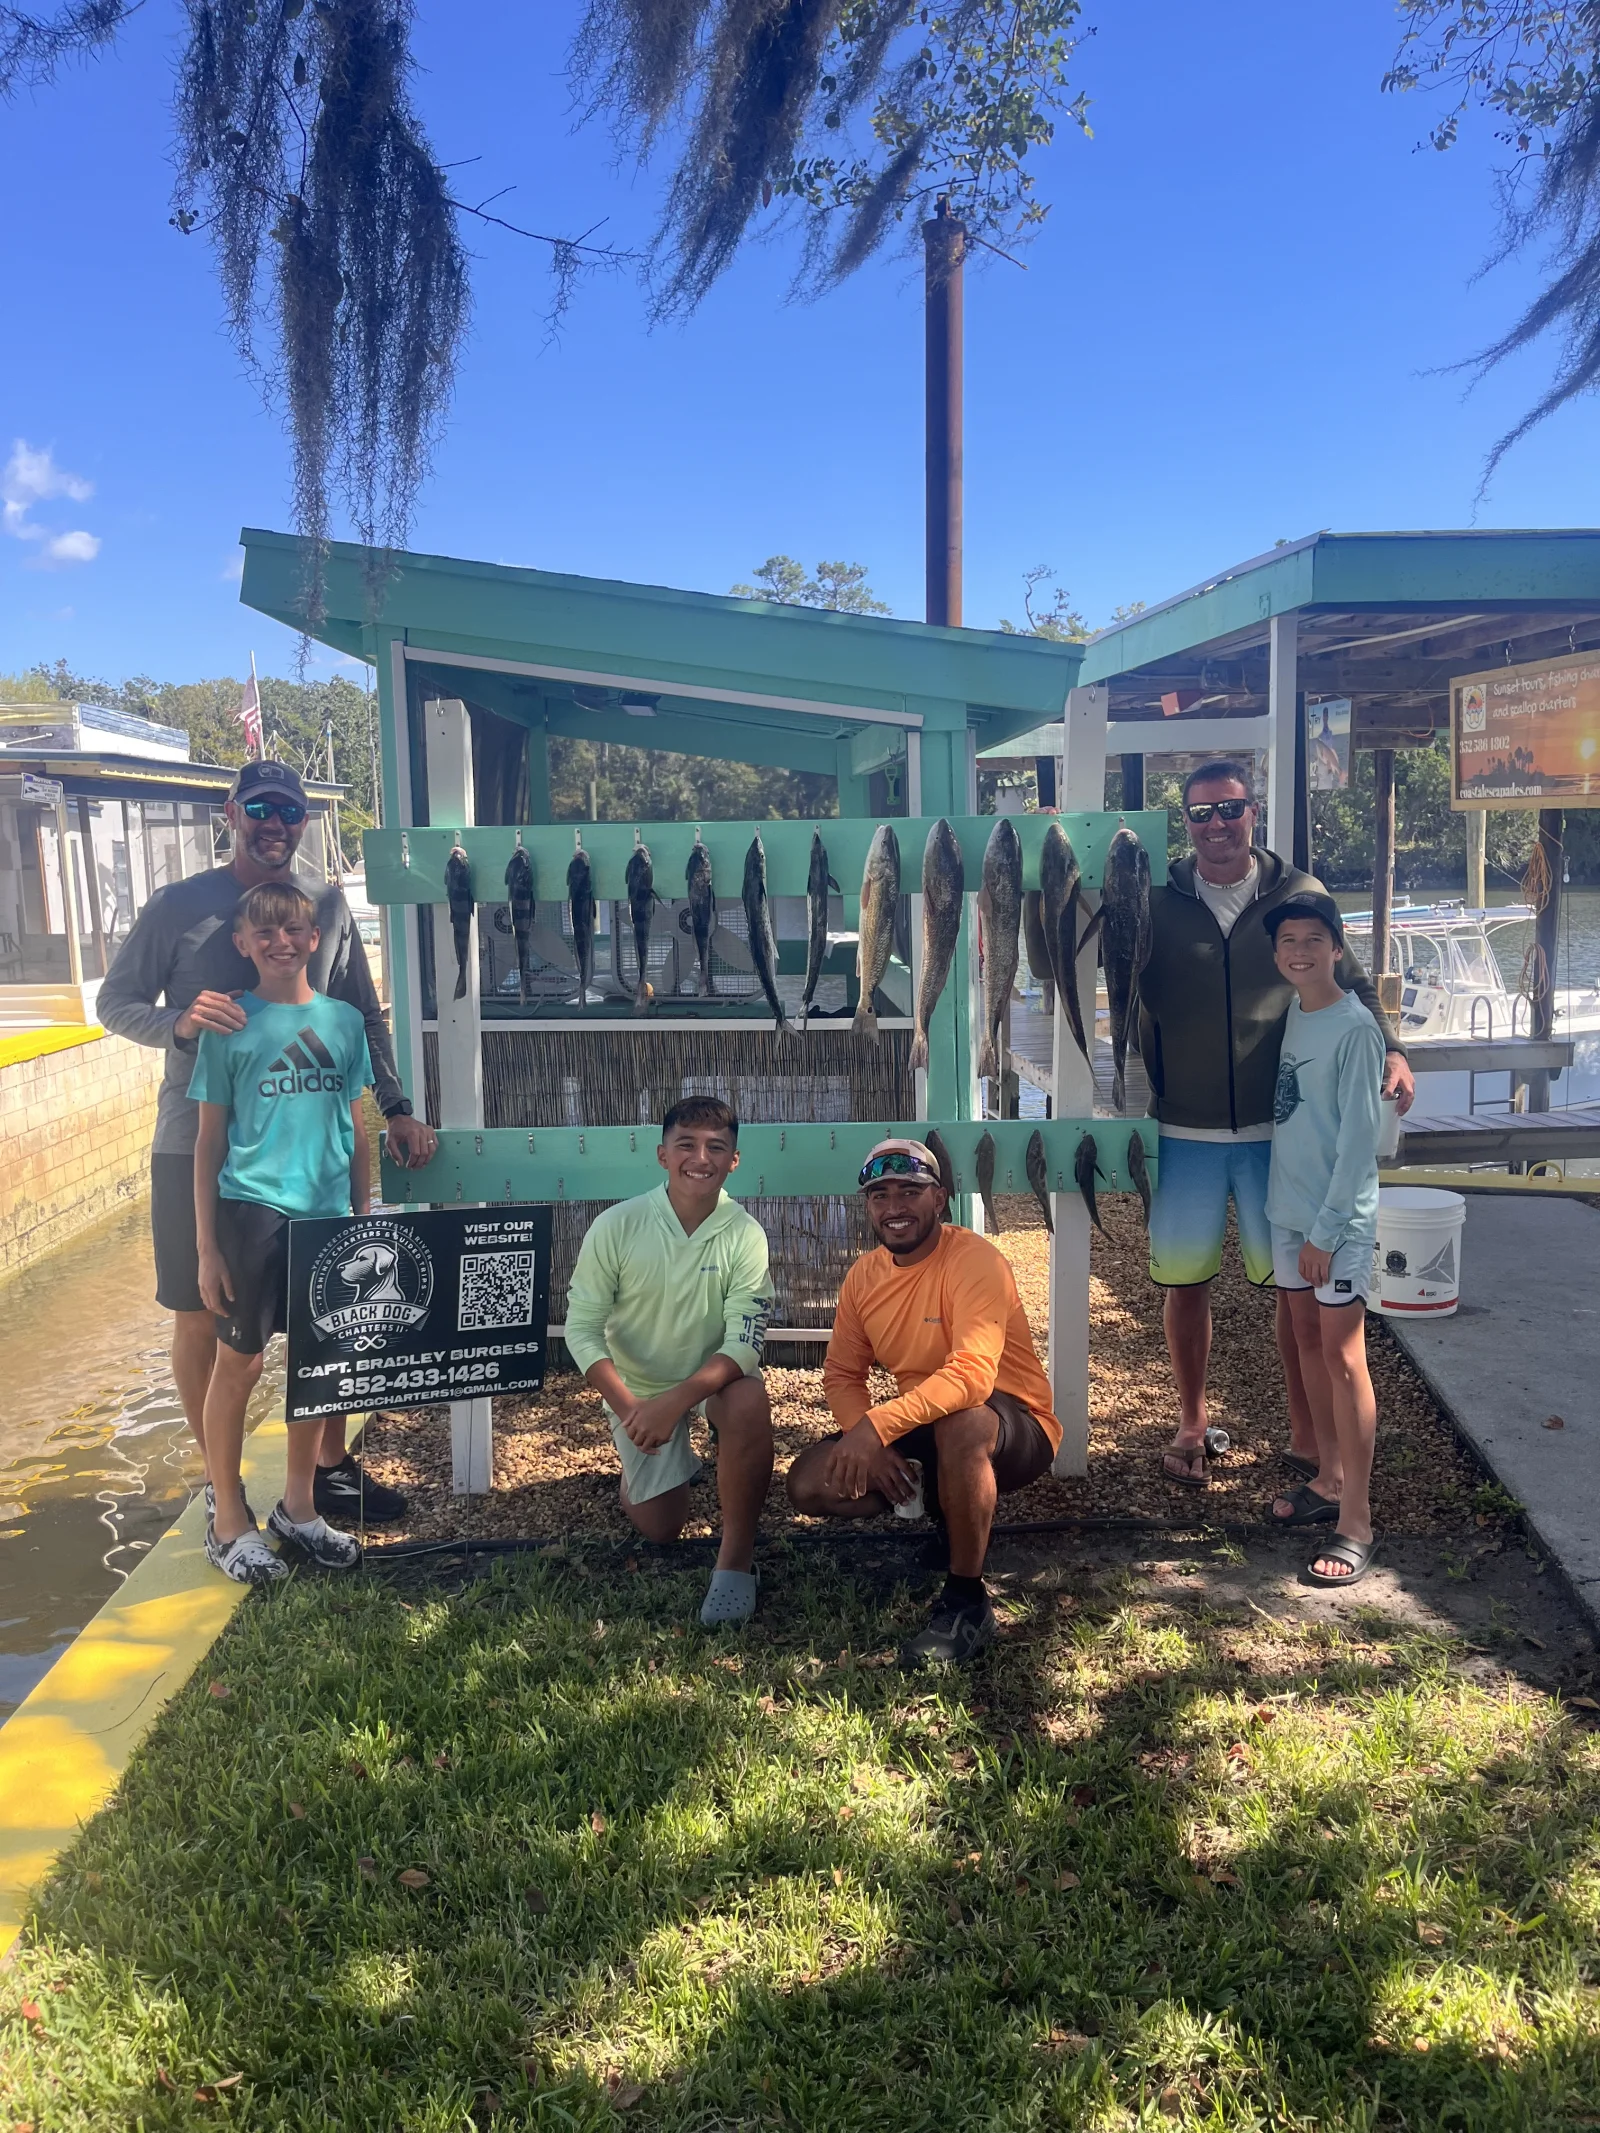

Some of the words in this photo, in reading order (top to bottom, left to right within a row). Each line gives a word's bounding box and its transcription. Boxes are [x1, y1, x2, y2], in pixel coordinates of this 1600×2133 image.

[1493, 678, 1520, 696] Sunset
[1548, 669, 1578, 691] fishing
[1492, 703, 1509, 718] and
[1510, 701, 1538, 718] scallop
[1539, 695, 1577, 712] charters
[1459, 740, 1473, 754] 352
[1459, 781, 1542, 799] coastalescapades.com
[258, 1068, 344, 1098] adidas
[464, 1222, 501, 1234] VISIT
[503, 1221, 534, 1231] OUR
[464, 1233, 533, 1246] WEBSITE!
[310, 1222, 364, 1270] YANKEETOWN
[375, 1220, 414, 1239] CRYSTAL
[414, 1235, 433, 1262] RIVER
[316, 1259, 332, 1300] FISHING
[332, 1230, 381, 1257] CHARTERS
[393, 1231, 422, 1260] GUIDED
[420, 1260, 428, 1290] TRIPS
[330, 1306, 377, 1329] BLACK
[382, 1304, 411, 1322] DOG
[337, 1323, 394, 1340] CHARTERS
[298, 1361, 352, 1379] CAPT.
[356, 1350, 446, 1373] BRADLEY
[450, 1341, 539, 1361] BURGESS
[338, 1361, 500, 1398] 352-433-1426
[293, 1378, 539, 1418] BLACKDOGCHARTERS1@GMAIL.COM
